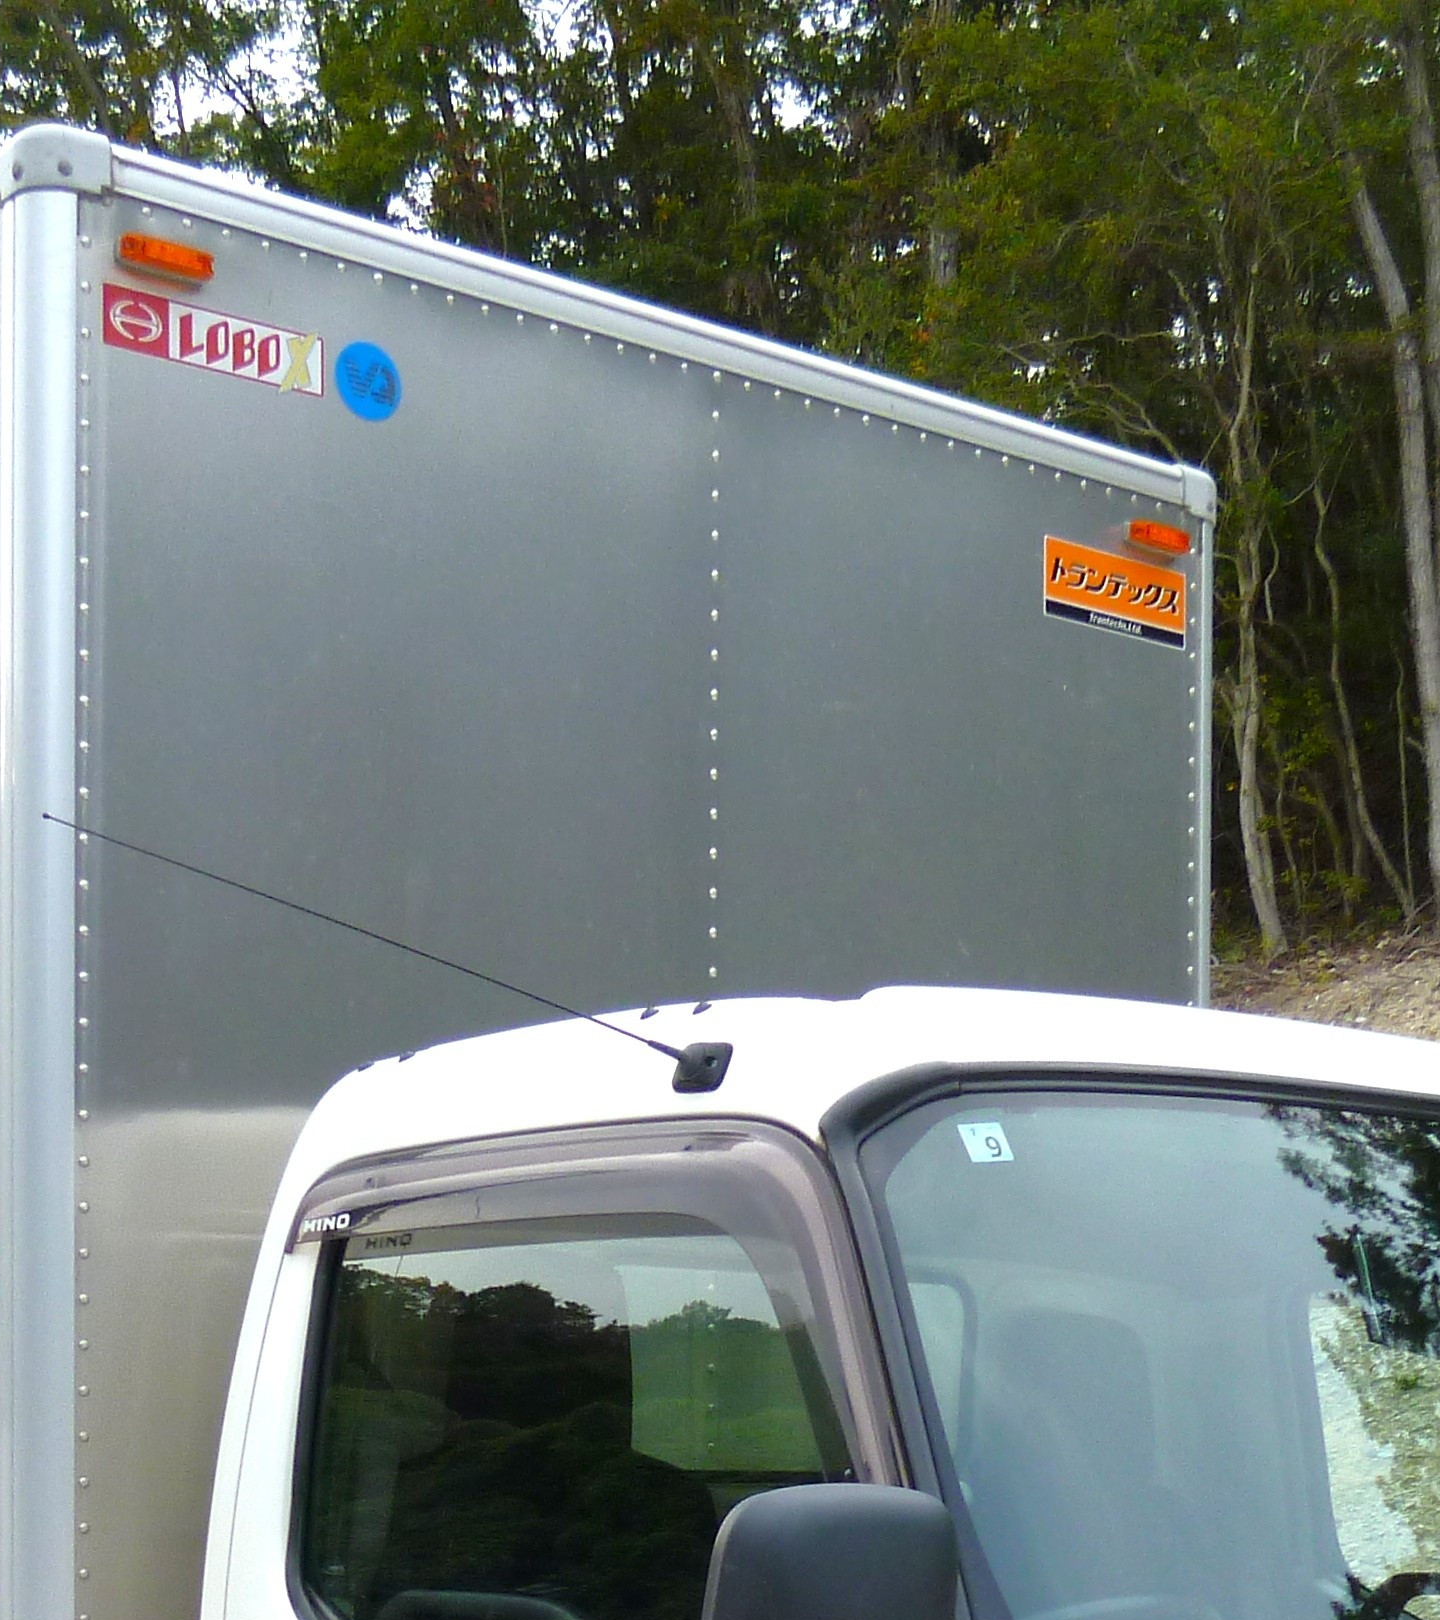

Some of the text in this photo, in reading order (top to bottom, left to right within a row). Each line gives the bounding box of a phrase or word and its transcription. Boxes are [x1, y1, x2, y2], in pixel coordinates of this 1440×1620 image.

[178, 312, 320, 394] LOBOX
[1050, 557, 1180, 615] トランテックス
[985, 1137, 1002, 1157] 9
[303, 1213, 351, 1232] HINO
[365, 1233, 413, 1249] HINO
